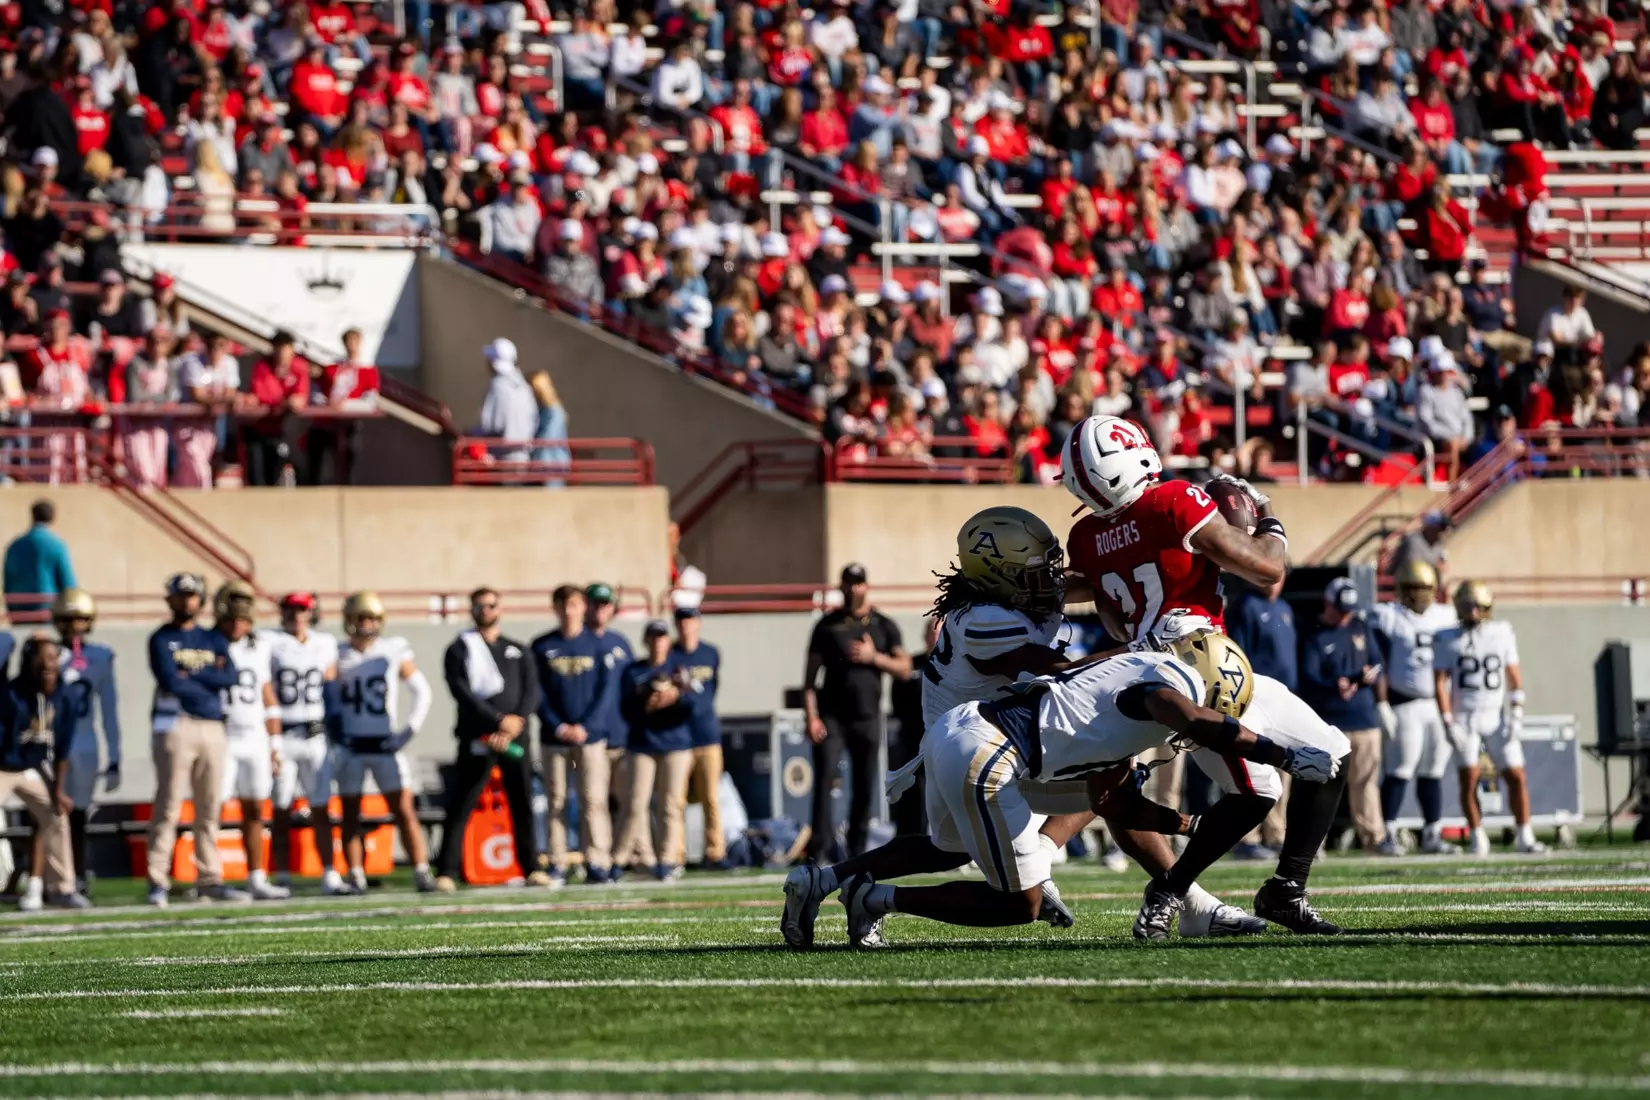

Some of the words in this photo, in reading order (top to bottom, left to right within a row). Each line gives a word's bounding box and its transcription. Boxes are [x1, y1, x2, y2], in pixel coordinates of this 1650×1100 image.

[969, 531, 1004, 559] A
[1095, 520, 1140, 557] ROGERS
[1217, 665, 1245, 703] A
[1457, 654, 1502, 691] 28
[340, 674, 387, 716] 43
[481, 834, 514, 869] G
